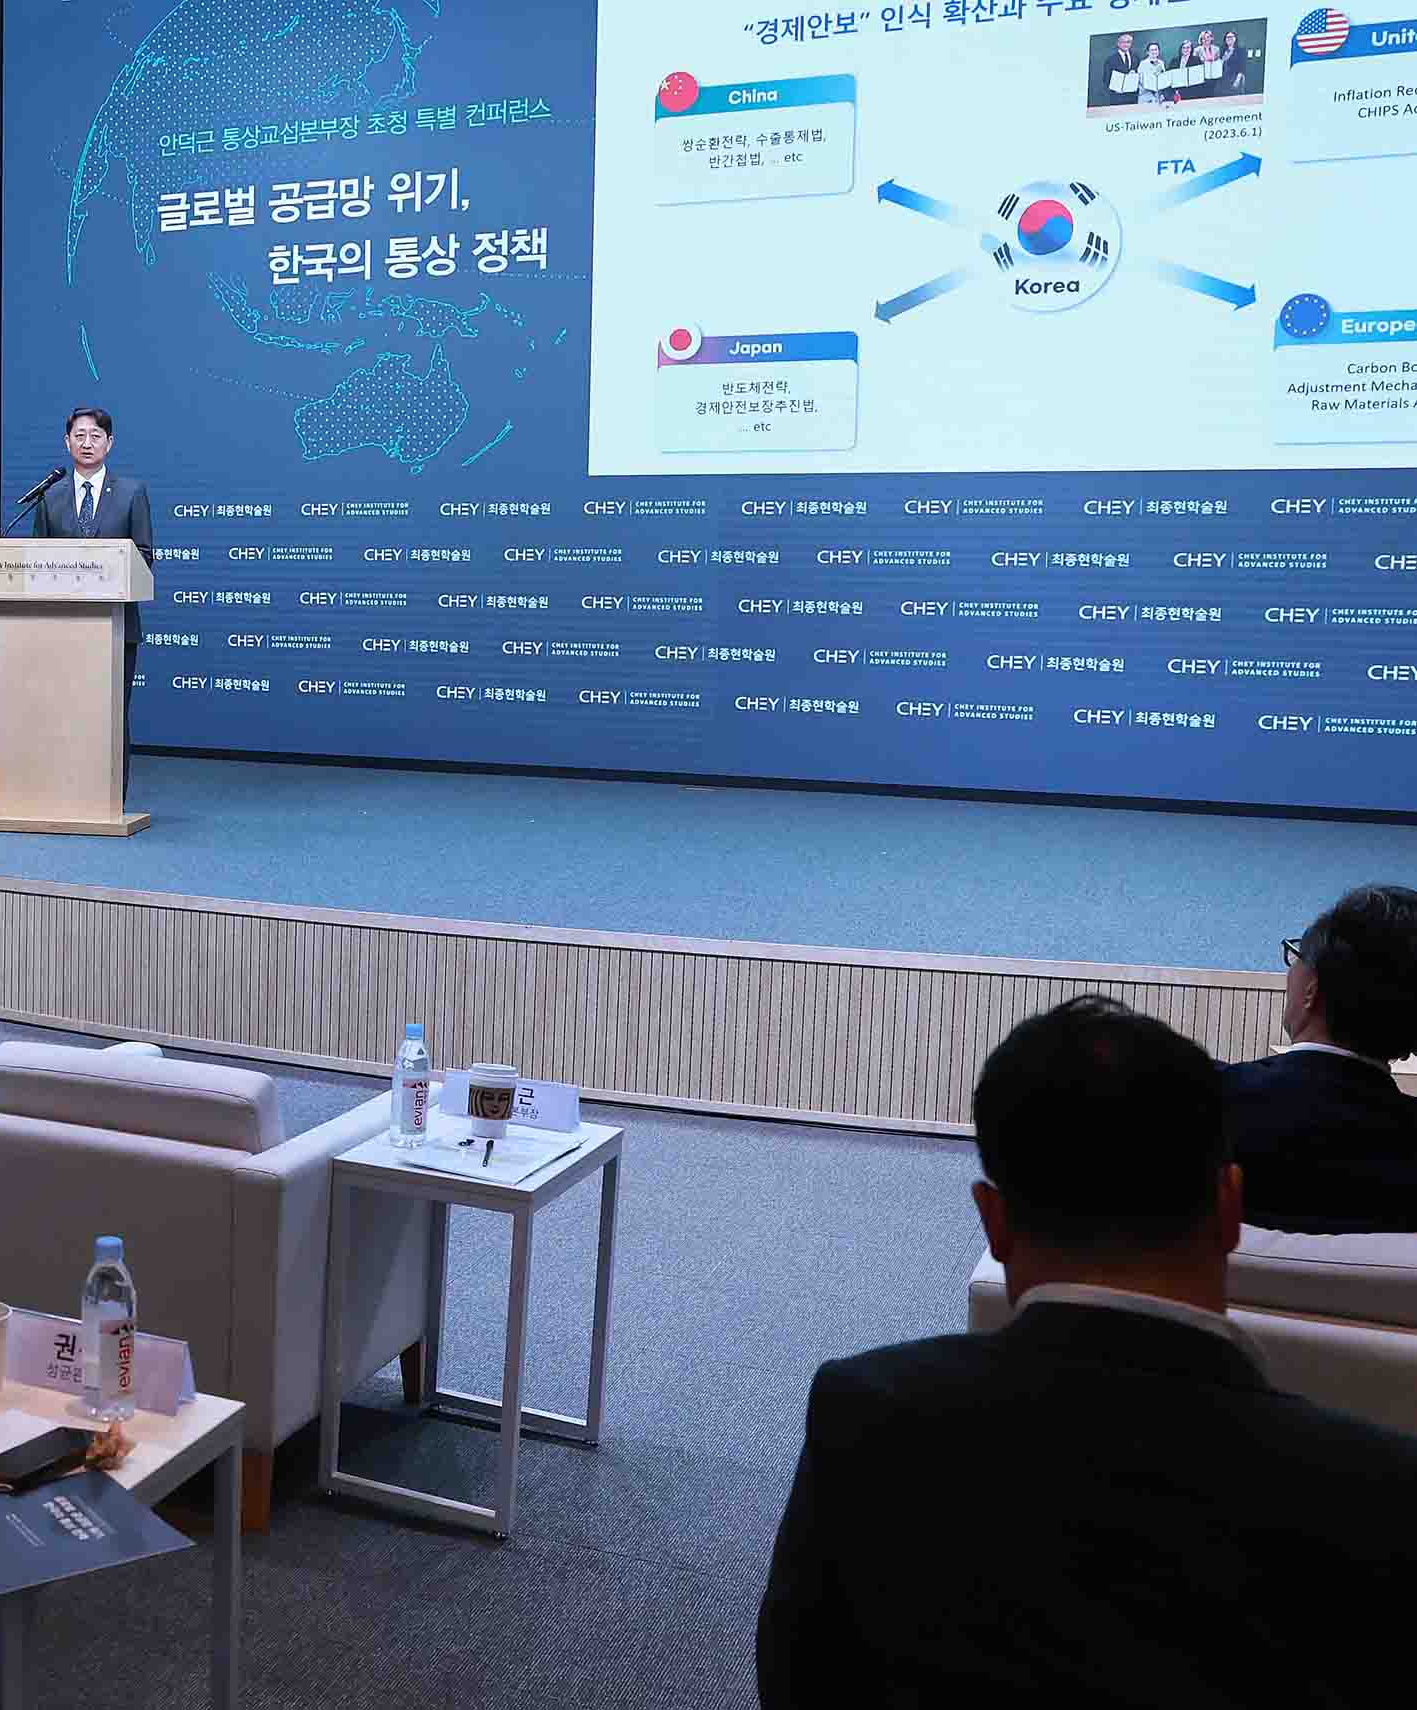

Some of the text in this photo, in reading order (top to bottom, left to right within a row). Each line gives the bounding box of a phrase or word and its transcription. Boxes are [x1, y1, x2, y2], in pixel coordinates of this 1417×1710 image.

[881, 6, 931, 33] 인식
[943, 0, 1026, 24] 확산과
[1371, 28, 1417, 47] Unit
[728, 88, 778, 105] China
[1333, 87, 1392, 102] Inflation
[1357, 104, 1399, 118] CHIPS
[159, 96, 552, 158] 안덕근 통상교섭본부장 초청 특별 컨퍼런스
[1105, 112, 1263, 133] US-Taiwan Trade Agreement
[756, 127, 827, 146] 수출통제법,
[1203, 126, 1263, 142] (2023.6.1)
[708, 151, 765, 170] 반간첩법,
[783, 151, 804, 163] etc
[1157, 159, 1196, 176] FTA
[158, 168, 471, 233] 글로벌 공급망 위기,
[268, 227, 549, 286] 한국의 통상 정책
[1014, 278, 1081, 296] Korea
[729, 340, 783, 358] Japan
[1347, 361, 1397, 374] Carbon
[721, 380, 791, 397] 반도체전략,
[1287, 381, 1366, 396] Adjustment
[695, 398, 819, 415] 경제안전보장추진법,
[1311, 397, 1410, 411] Raw Materials
[753, 420, 772, 433] etc
[174, 505, 271, 516] CHEY 최종현학술원
[302, 504, 338, 515] CHEY
[440, 503, 550, 515] CHEY 최종현학술원
[584, 502, 625, 514] CHEY
[742, 502, 866, 514] CHEY 최종현학술원
[905, 501, 952, 513] CHEY
[1084, 501, 1227, 514] CHEY 최종현학술원
[1271, 499, 1326, 513] CHEY
[153, 549, 199, 560] 종현학술원
[229, 548, 264, 559] CHEY
[364, 549, 470, 561] CHEY 최종현학술원
[504, 549, 544, 561] CHEY
[658, 550, 778, 563] CHEY 최종현학술원
[817, 551, 862, 563] CHEY
[992, 553, 1129, 567] CHEY 최종현학술원
[1174, 553, 1226, 567] CHEY
[174, 591, 270, 603] CHEY 최종현학술원
[300, 592, 336, 604] CHEY
[439, 595, 548, 608] CHEY 최종현학술원
[582, 597, 623, 609] CHEY
[739, 600, 862, 614] CHEY 최종현학술원
[901, 602, 948, 615] CHEY
[1079, 606, 1221, 621] CHEY 최종현학술원
[1265, 608, 1319, 622] CHEY
[146, 634, 198, 645] 최종현학술원
[228, 635, 263, 647] CHEY
[363, 639, 468, 653] CHEY 최종현학술원
[503, 642, 542, 654] CHEY
[656, 646, 775, 661] CHEY 최종현학술원
[814, 649, 859, 663] CHEY
[987, 655, 1124, 672] CHEY 최종현학술원
[1168, 659, 1220, 674] CHEY
[173, 677, 269, 691] CHEY 최종현학술원
[299, 681, 335, 692] CHEY
[437, 686, 545, 701] CHEY 최종현학술원
[579, 691, 620, 703] CHEY
[735, 697, 858, 713] CHEY 최종현학술원
[897, 702, 944, 716] CHEY
[1074, 709, 1214, 727] CHEY 최종현학술원
[1259, 716, 1313, 730] CHEY
[413, 1086, 424, 1129] evian
[118, 1334, 135, 1393] evian
